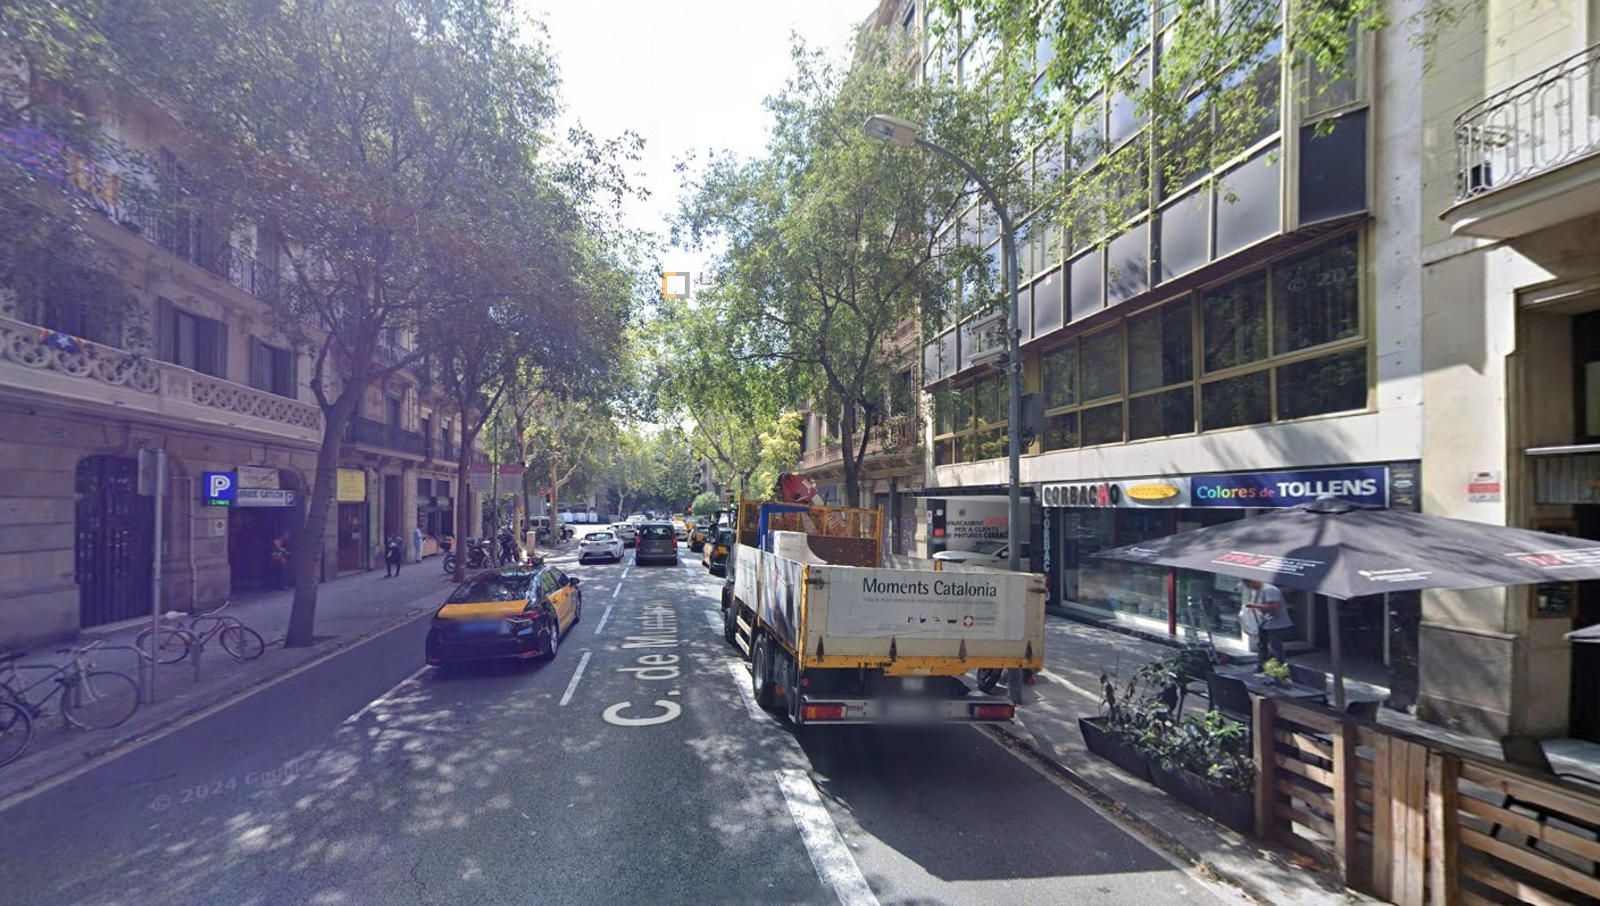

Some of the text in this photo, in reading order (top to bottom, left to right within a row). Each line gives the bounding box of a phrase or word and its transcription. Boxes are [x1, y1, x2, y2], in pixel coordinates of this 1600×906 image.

[209, 474, 231, 498] P
[1196, 483, 1257, 499] Colores
[1259, 487, 1275, 498] de
[1277, 478, 1378, 498] TOLLENS
[862, 578, 997, 597] Moments Catalonia
